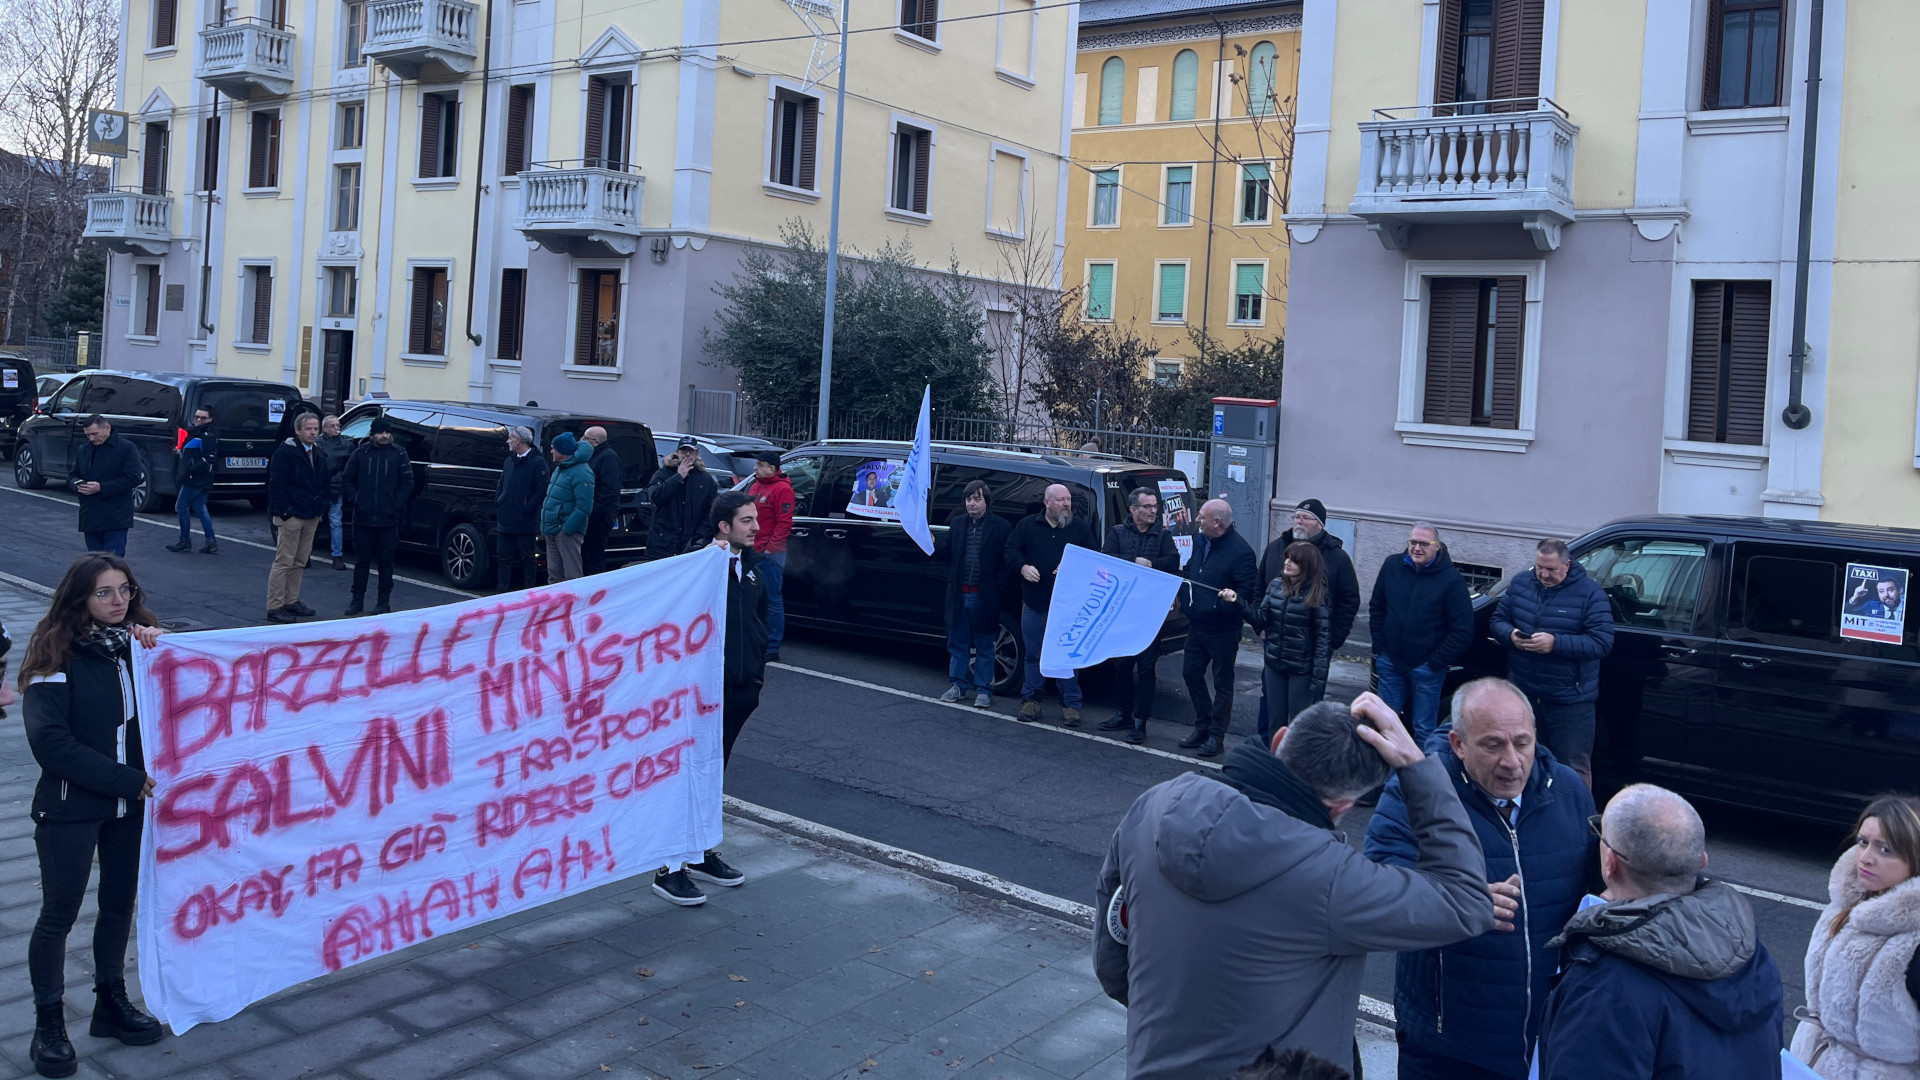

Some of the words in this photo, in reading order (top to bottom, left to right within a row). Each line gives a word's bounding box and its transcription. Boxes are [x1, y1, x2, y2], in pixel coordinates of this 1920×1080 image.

[1167, 498, 1182, 511] TAXI
[1179, 538, 1191, 548] TAXI
[1854, 569, 1876, 579] TAXI
[1844, 616, 1868, 627] MIT
[156, 708, 452, 863] SALVINI
[478, 609, 714, 734] MINISTRO
[306, 842, 364, 898] FA
